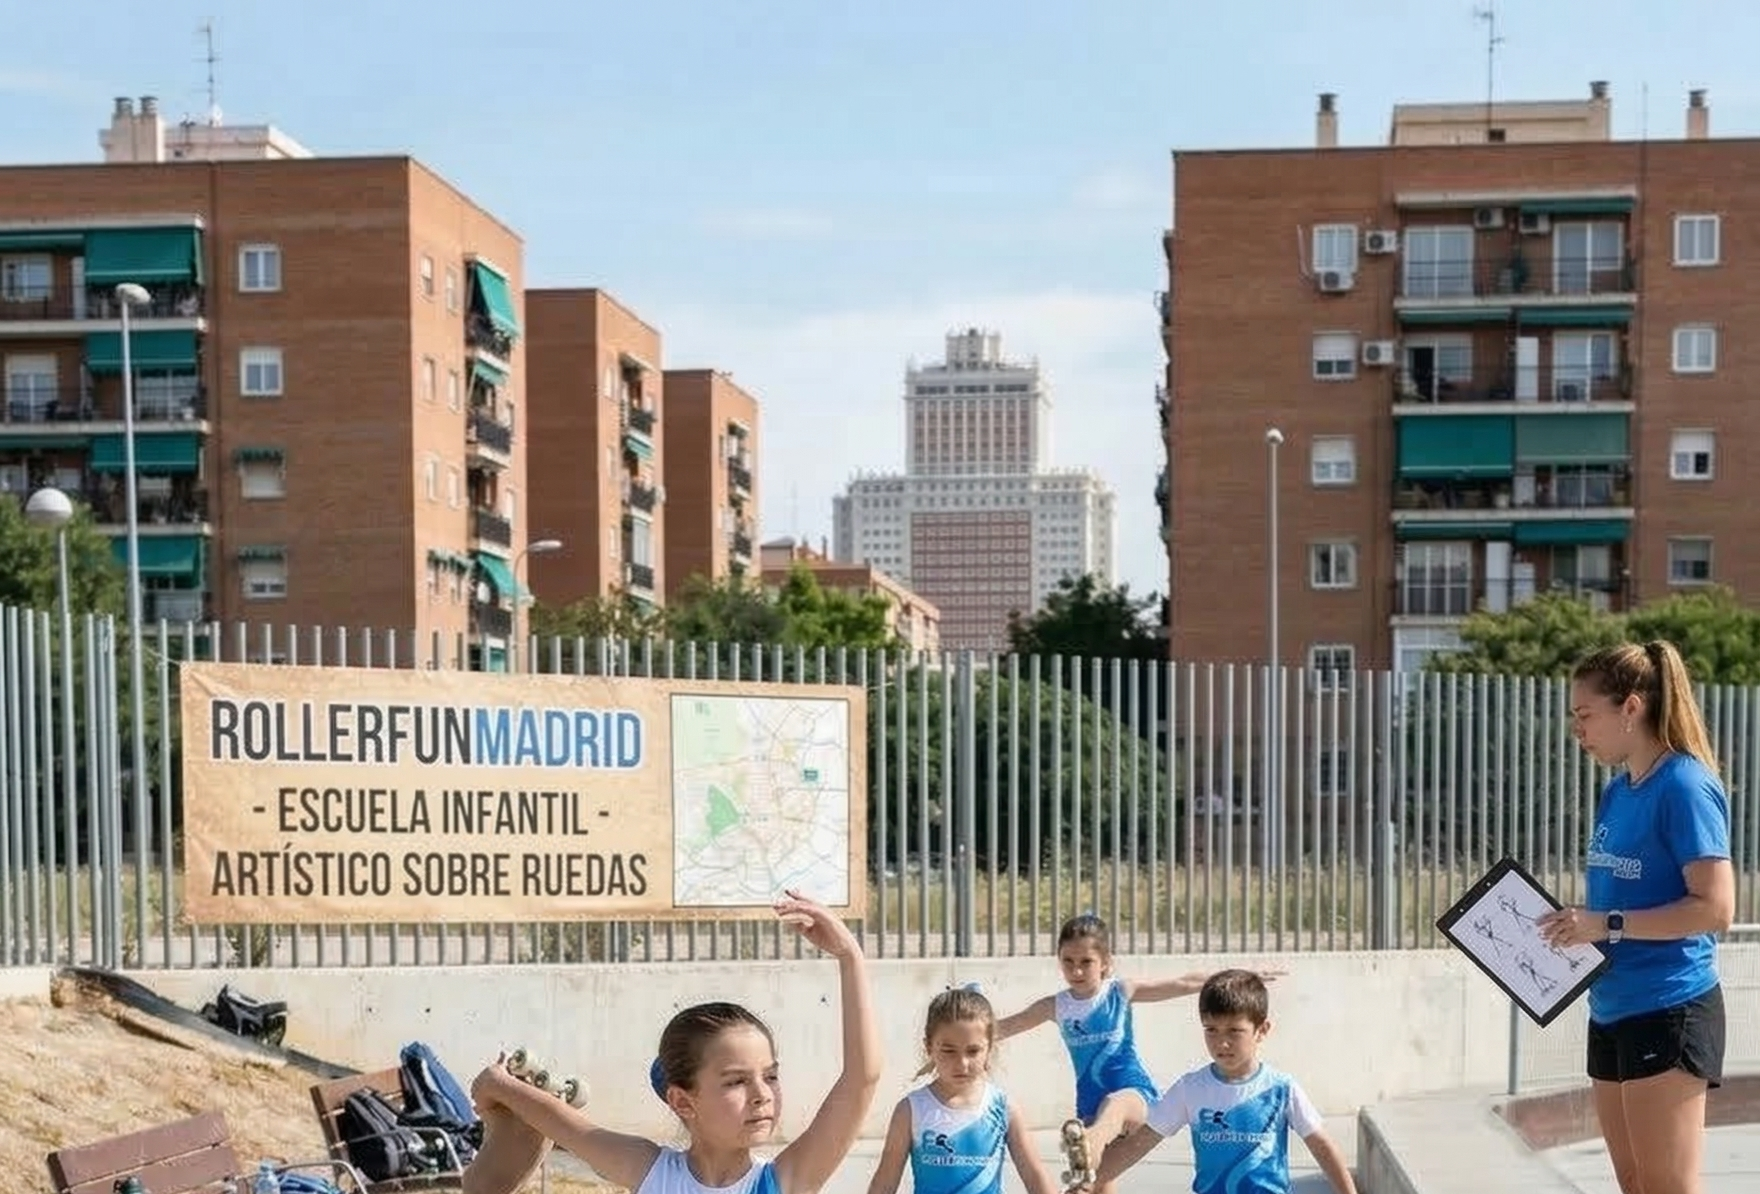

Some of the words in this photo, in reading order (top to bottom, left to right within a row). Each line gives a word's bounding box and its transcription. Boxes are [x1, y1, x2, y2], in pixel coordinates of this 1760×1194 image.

[211, 699, 642, 769] ROLLERFUNMADRID
[278, 787, 432, 834] ESCUELA
[442, 790, 589, 835] INFANTIL
[211, 841, 391, 896] ARTÍSTICO
[402, 852, 511, 897] SOBRE
[522, 853, 648, 897] RUEDAS
